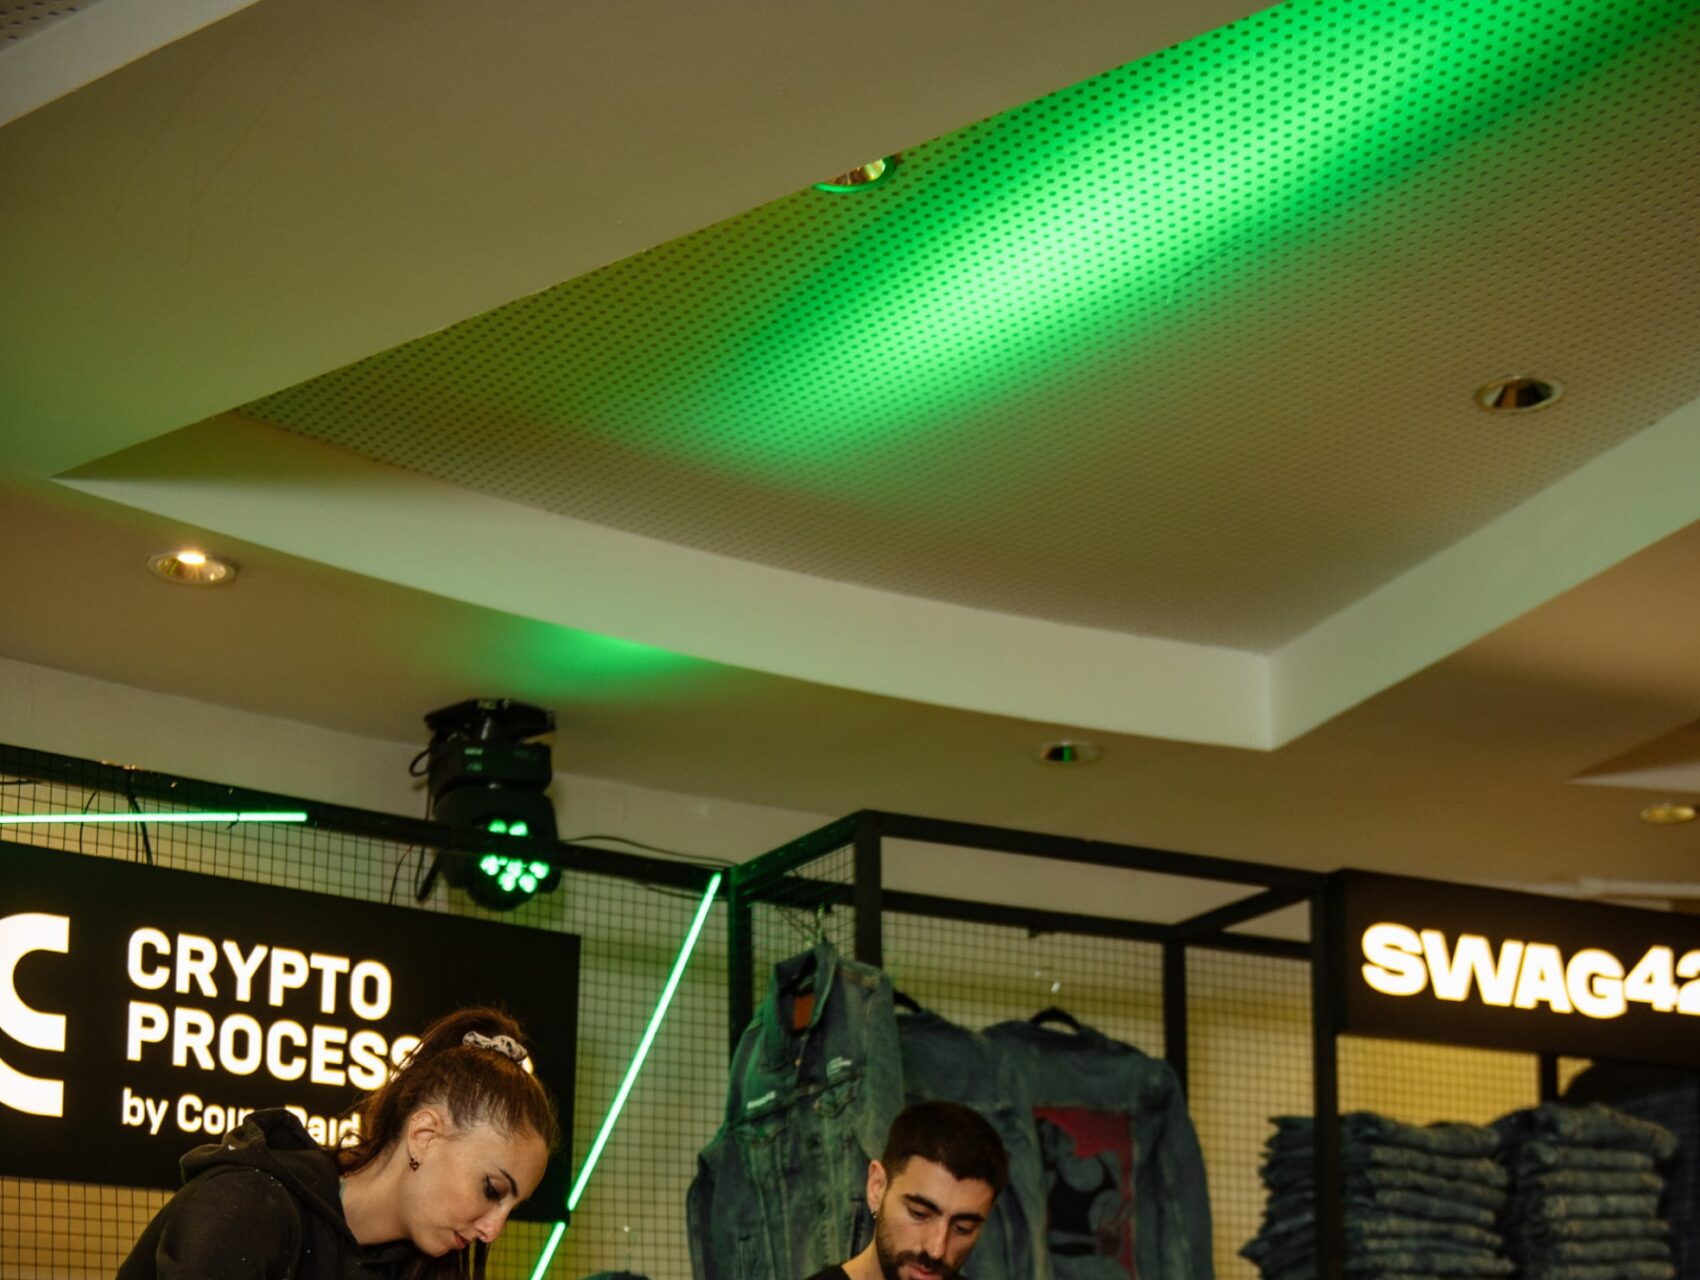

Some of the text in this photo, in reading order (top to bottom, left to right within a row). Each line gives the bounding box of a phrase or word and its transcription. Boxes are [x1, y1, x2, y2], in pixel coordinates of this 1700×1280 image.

[127, 927, 392, 1021] CRYPTO
[127, 1000, 533, 1091] PROCES
[122, 1087, 169, 1135] by
